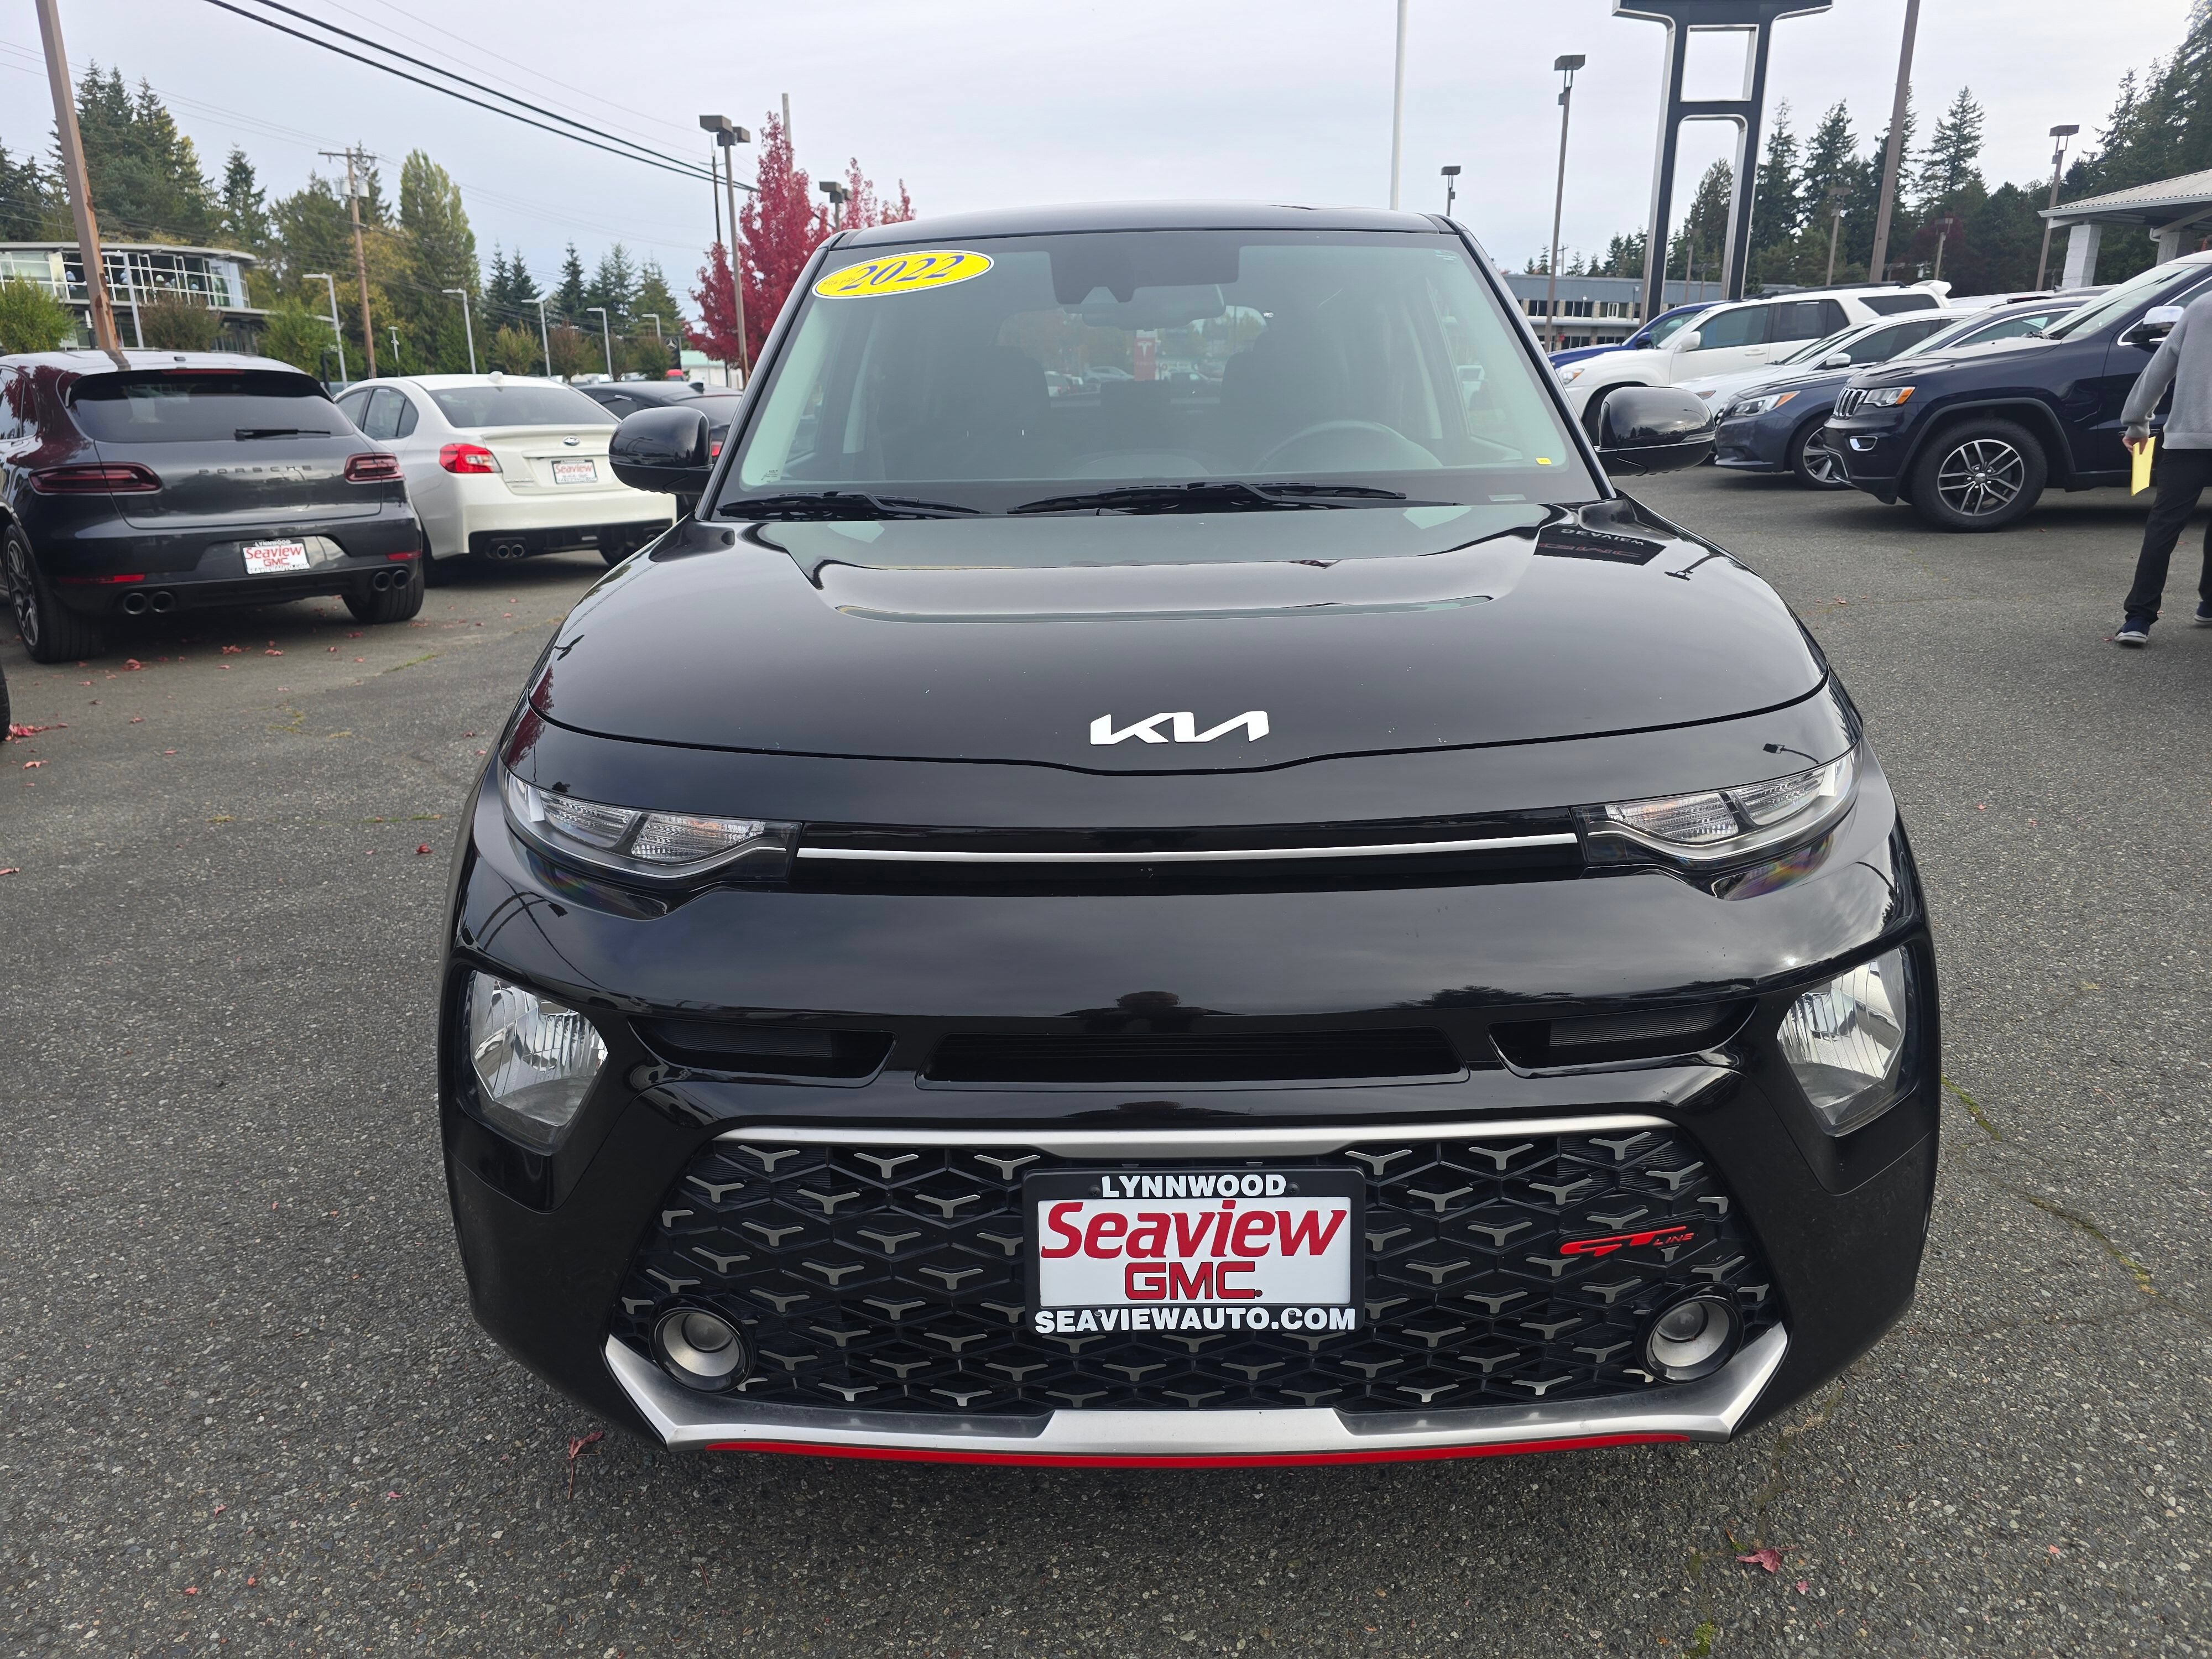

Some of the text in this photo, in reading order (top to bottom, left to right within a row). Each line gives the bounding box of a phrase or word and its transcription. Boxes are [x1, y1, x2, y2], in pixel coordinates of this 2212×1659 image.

[836, 255, 964, 291] 2022
[199, 465, 312, 475] PORSCHE
[556, 463, 593, 474] Seaview
[245, 545, 302, 560] Seaview
[263, 557, 289, 566] GMC
[1090, 711, 1270, 745] KIA
[1101, 1174, 1286, 1198] LYNNWOOD
[1040, 1199, 1347, 1259] Seaview
[1560, 1225, 1694, 1257] GT LINE
[1124, 1261, 1255, 1301] GMC
[1035, 1308, 1355, 1333] SEAVIEWAUTO.COM
